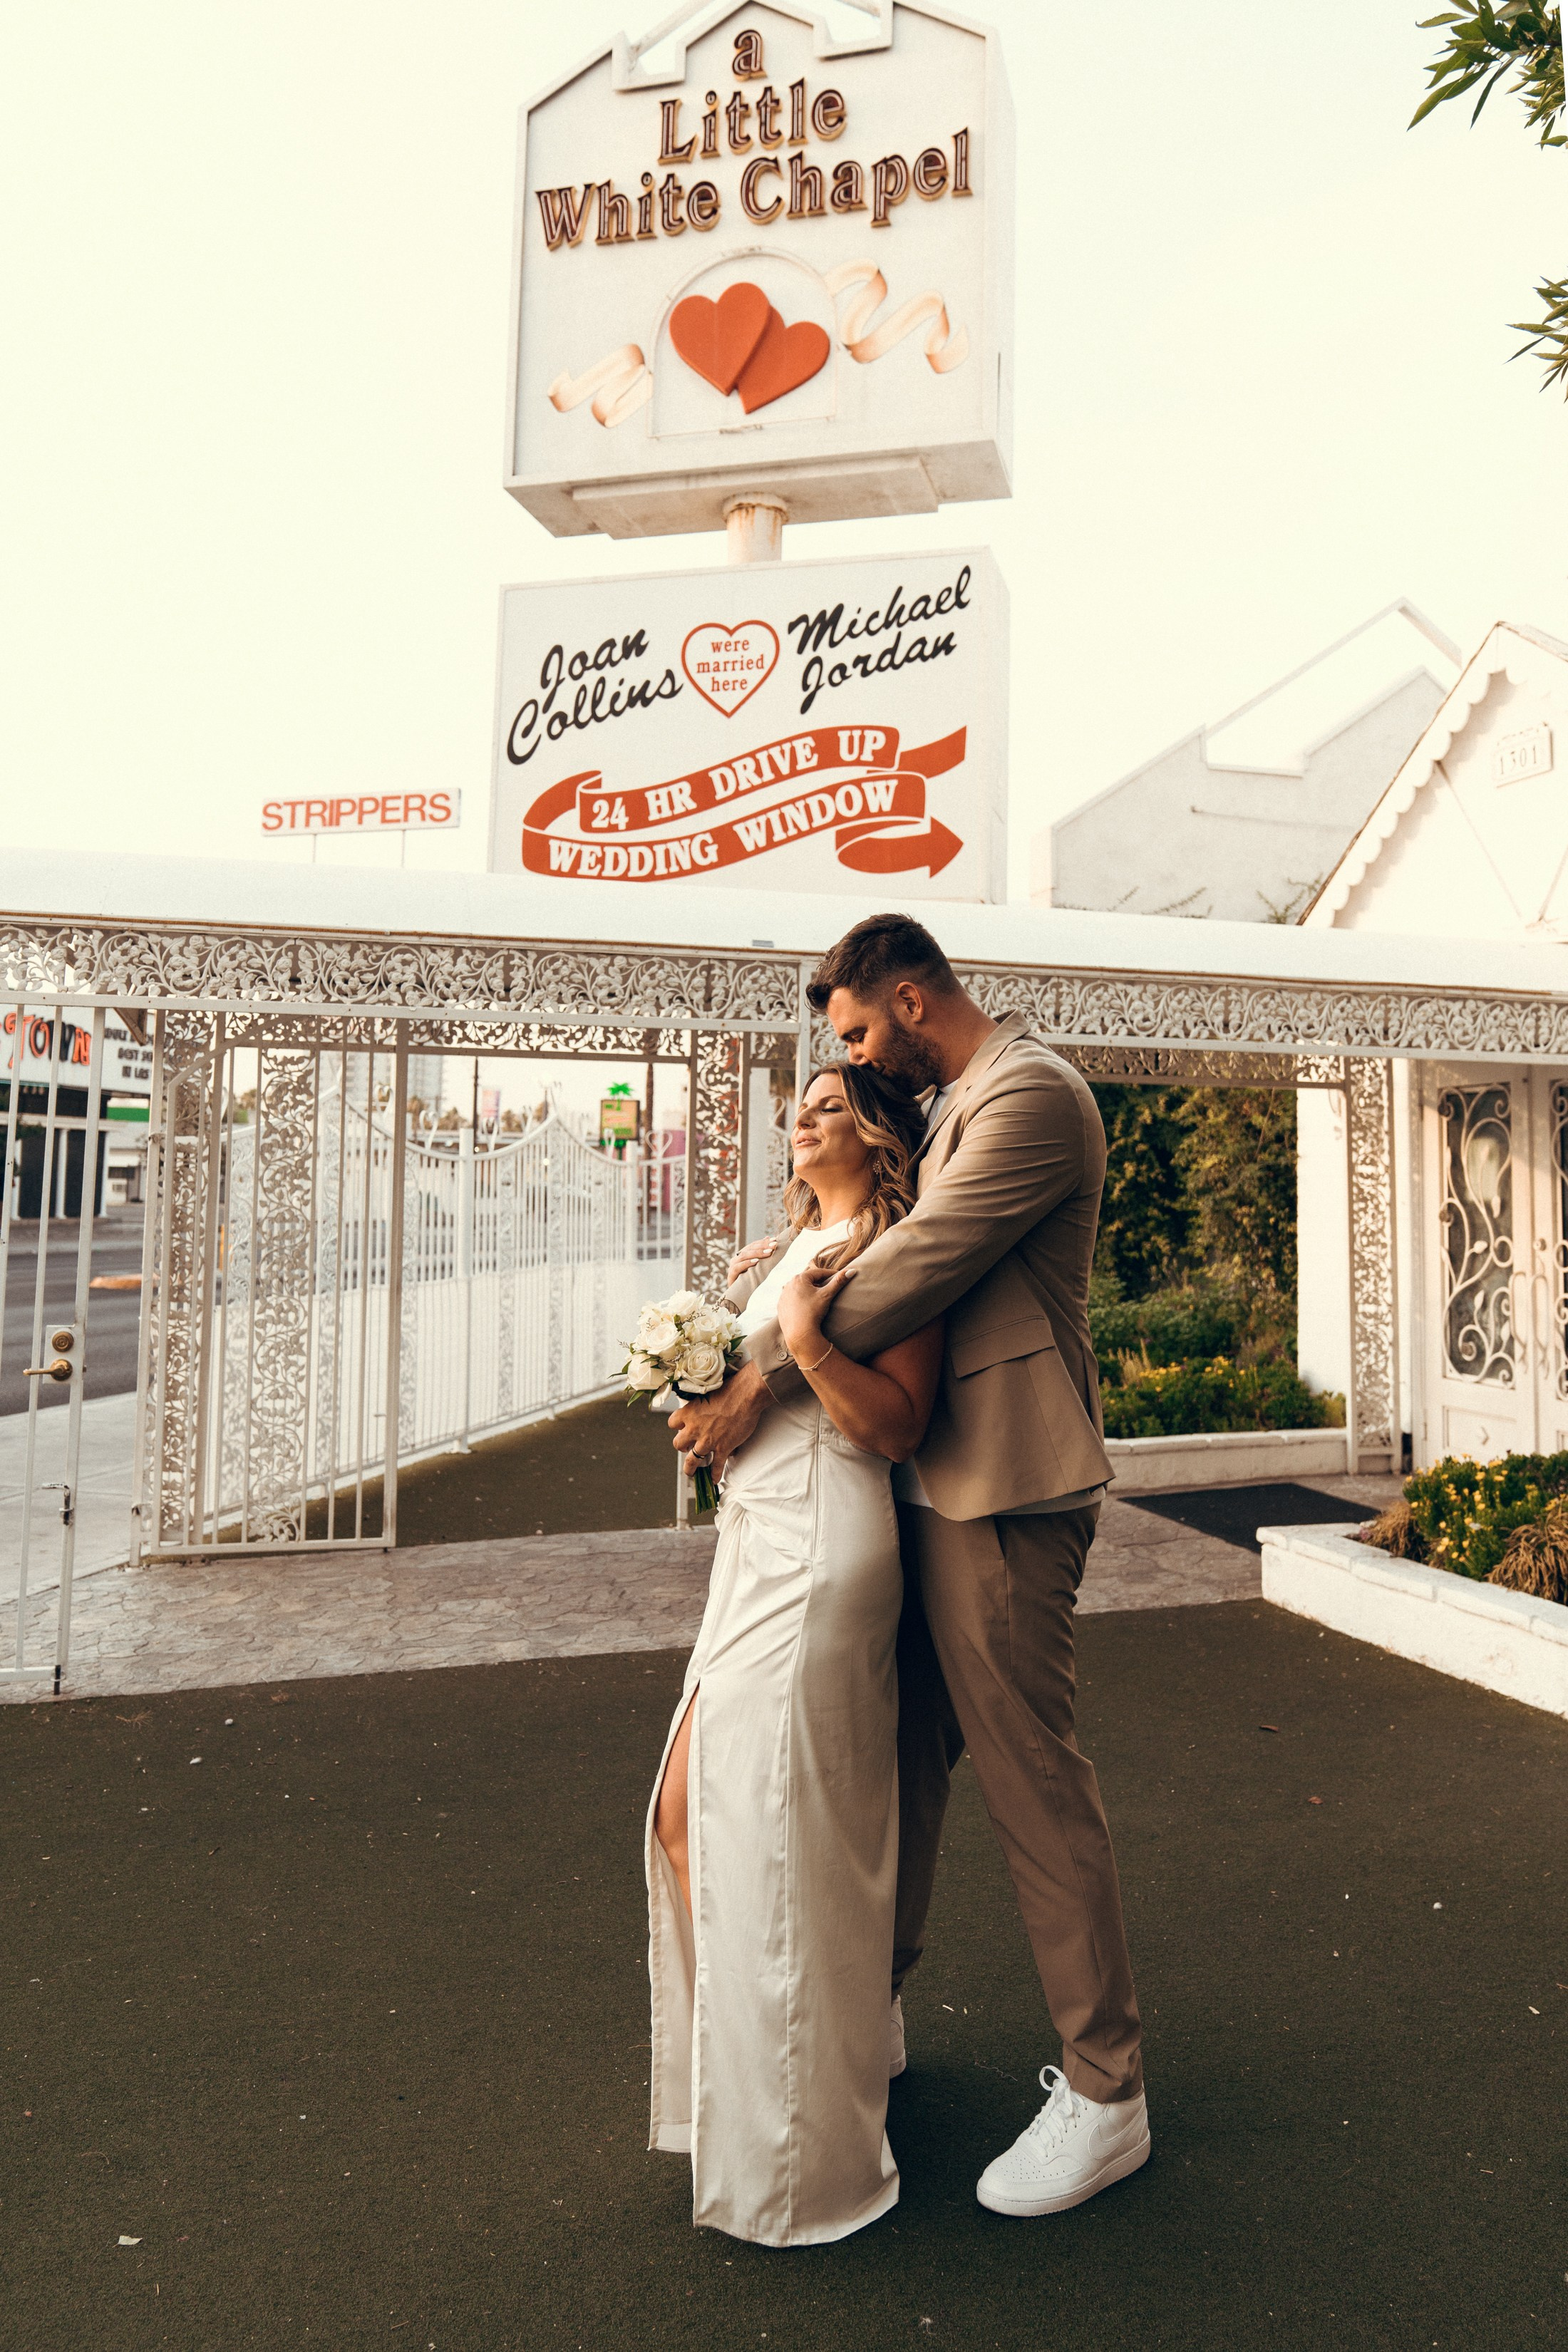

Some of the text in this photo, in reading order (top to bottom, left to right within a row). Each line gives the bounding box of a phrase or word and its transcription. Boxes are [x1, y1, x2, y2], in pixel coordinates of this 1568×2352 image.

[732, 29, 766, 80] a
[658, 78, 846, 165] Little
[535, 127, 974, 251] White Chapel
[711, 638, 750, 653] were
[788, 565, 971, 654] Michael
[539, 629, 649, 714] Joan
[696, 655, 765, 674] married
[711, 676, 748, 691] here
[800, 632, 956, 714] Jordan
[507, 669, 684, 765] Collins
[262, 793, 452, 830] STRIPPERS
[591, 729, 886, 831] 24 HR DRIVE UP
[548, 780, 898, 878] WEDDING WINDOW
